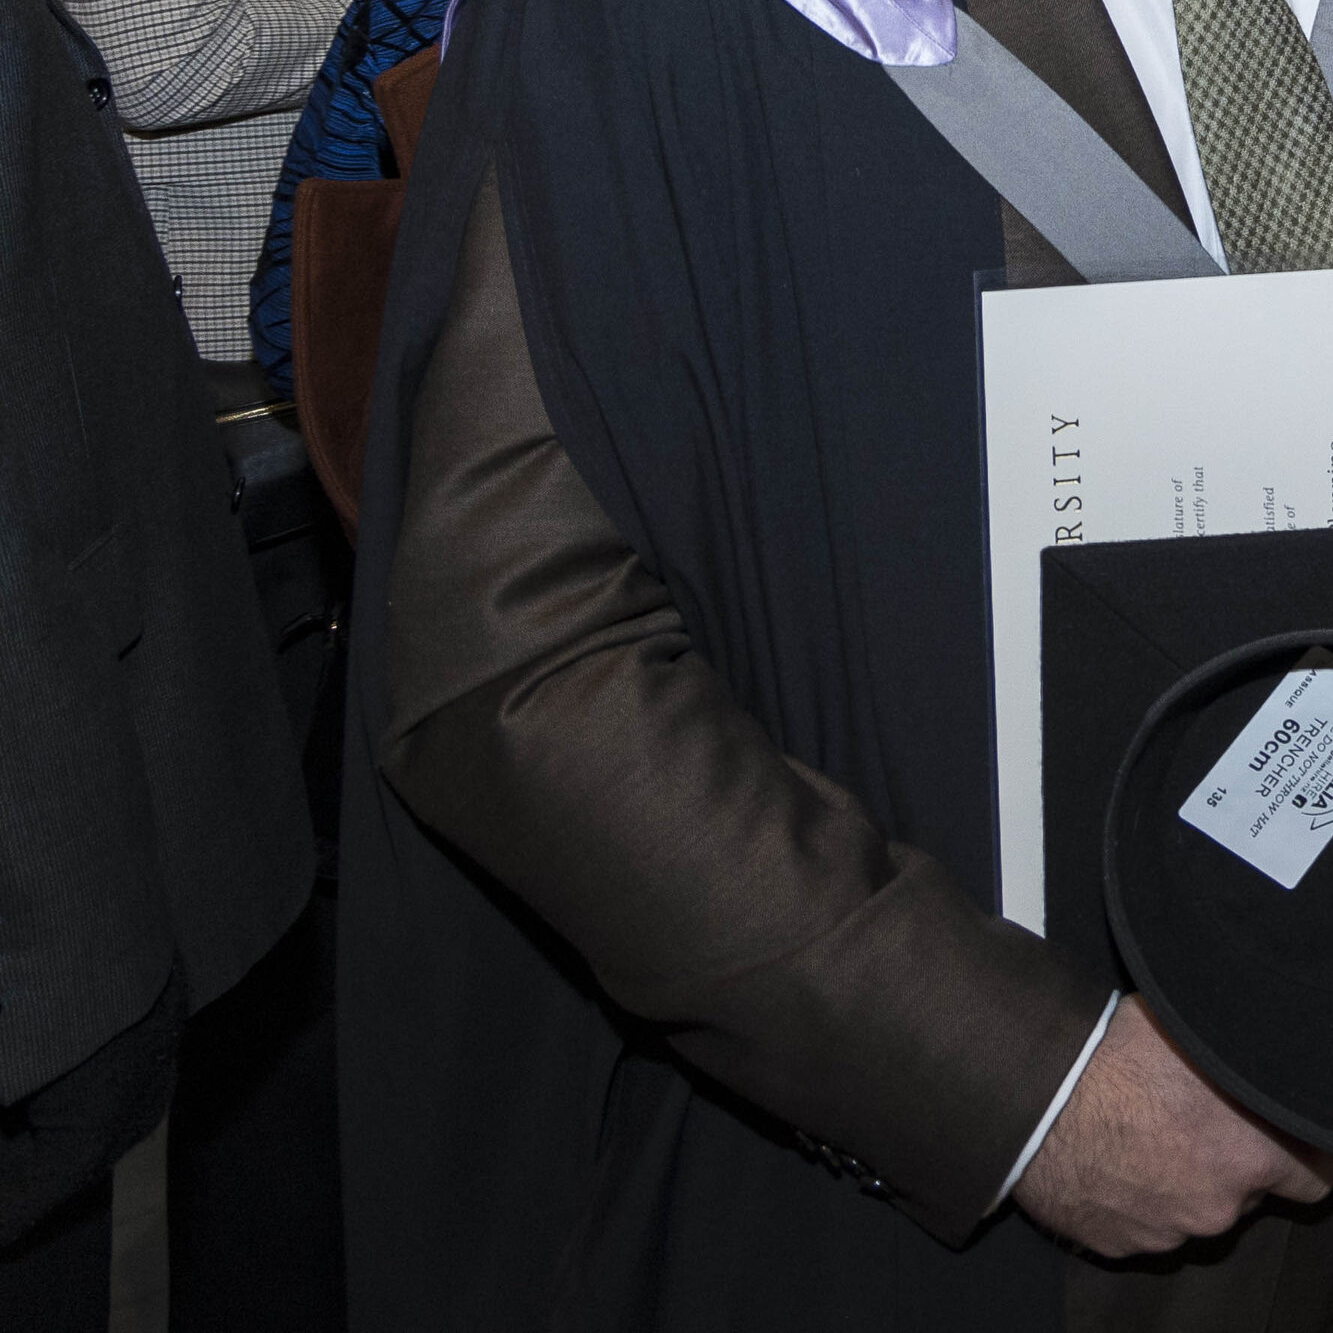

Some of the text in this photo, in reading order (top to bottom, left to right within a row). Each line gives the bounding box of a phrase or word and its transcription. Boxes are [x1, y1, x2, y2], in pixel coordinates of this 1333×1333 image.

[1171, 477, 1184, 493] of
[1193, 467, 1204, 493] that
[1284, 504, 1295, 519] of
[1248, 719, 1300, 771] 60cm
[1317, 734, 1333, 752] DO
[1255, 718, 1328, 797] TRENCHER
[1298, 751, 1319, 777] NOT
[1207, 787, 1227, 807] 135
[1268, 775, 1301, 815] THROW
[1305, 770, 1332, 800] HIRE
[1250, 812, 1269, 838] HAT
